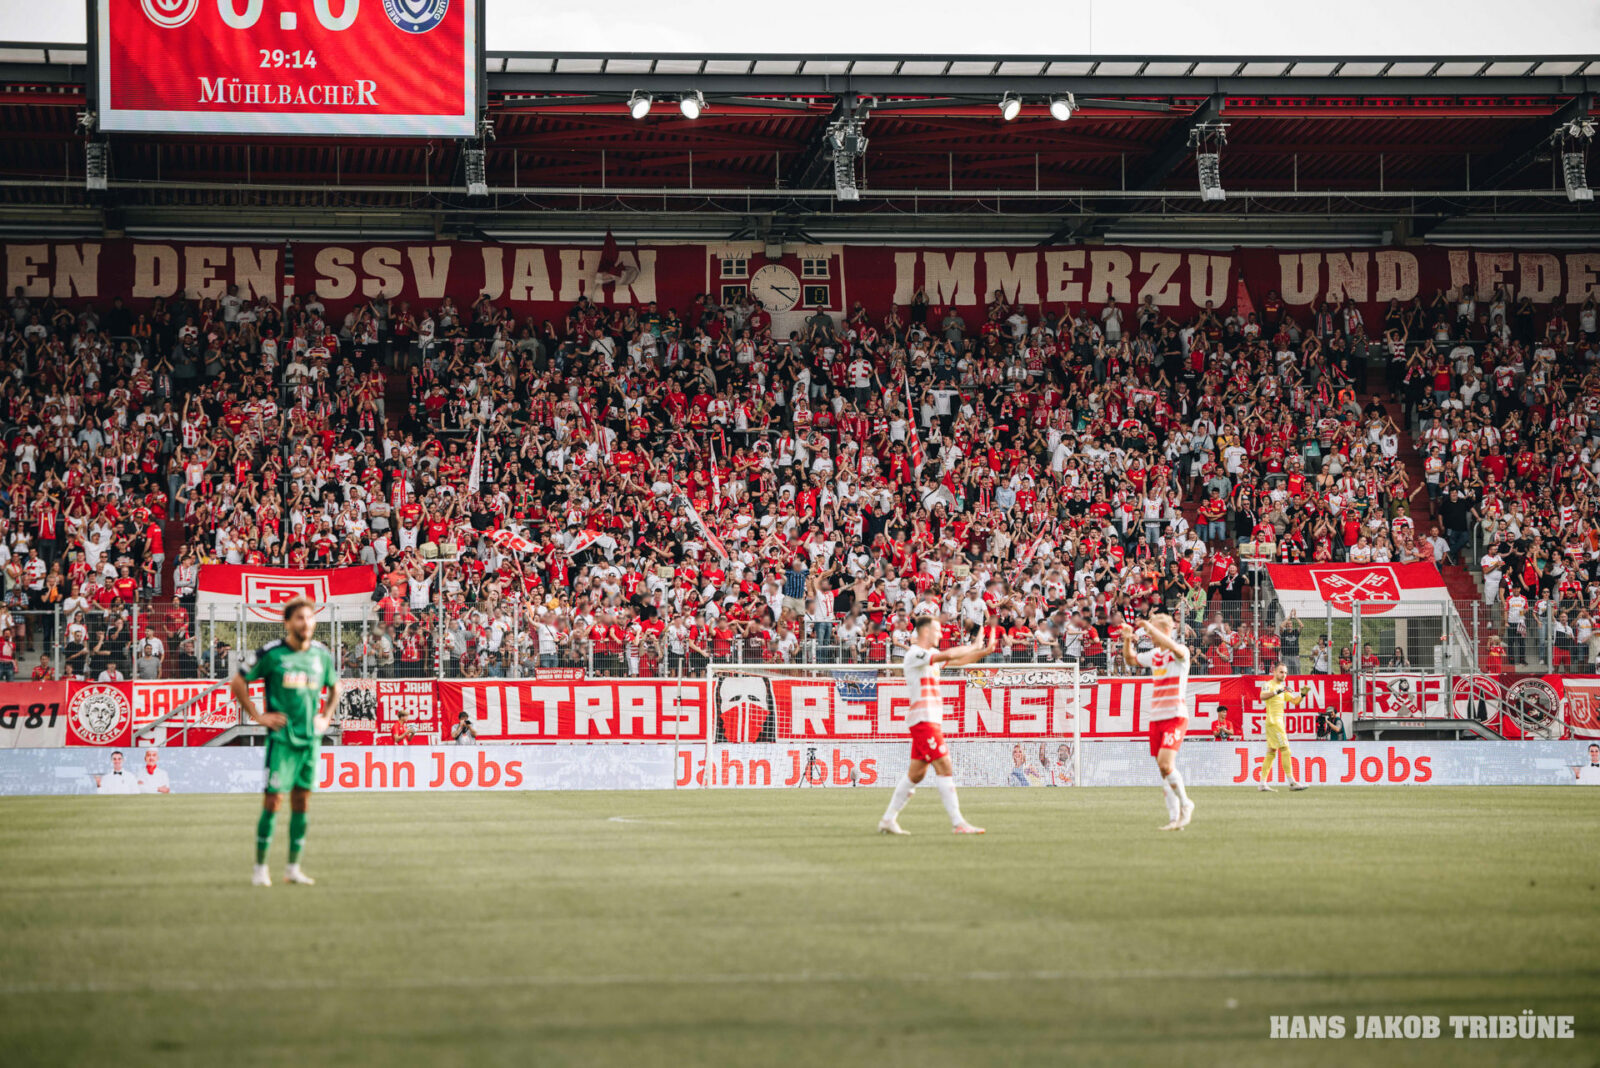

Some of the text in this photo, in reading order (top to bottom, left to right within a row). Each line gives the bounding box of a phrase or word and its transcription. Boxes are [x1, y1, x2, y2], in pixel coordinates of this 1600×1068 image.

[259, 49, 317, 69] 29:14
[197, 77, 379, 106] MÜHLBACHER
[5, 243, 101, 298] EN
[132, 243, 279, 302] DEN
[314, 246, 452, 299] SSV
[479, 247, 656, 304] JAHN
[893, 250, 1232, 309] IMMERZU
[1278, 250, 1419, 305] UND
[380, 682, 401, 693] SSV
[404, 681, 433, 693] JAHN
[1023, 668, 1097, 686] GENERAON
[380, 695, 433, 721] 1889
[461, 682, 1221, 736] ULTRAS REGNSBUG
[1252, 680, 1326, 710] JHN
[381, 723, 434, 733] REURG
[319, 750, 523, 789] Jahn Jobs
[676, 749, 878, 787] Jahn Jobs
[1233, 747, 1433, 783] Jahn Jobs
